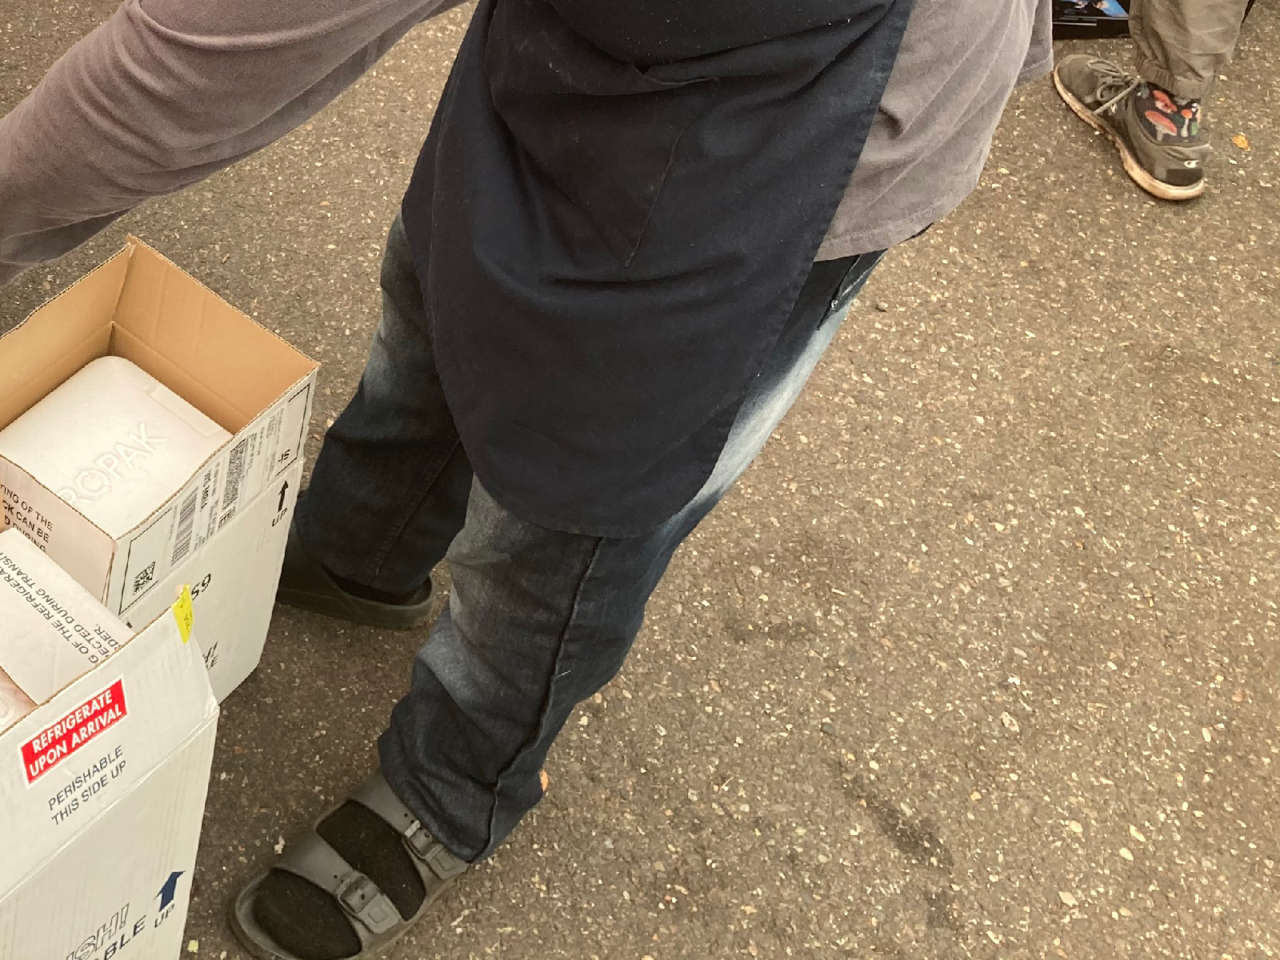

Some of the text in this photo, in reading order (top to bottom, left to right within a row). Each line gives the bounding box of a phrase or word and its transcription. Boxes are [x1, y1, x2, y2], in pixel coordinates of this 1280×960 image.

[16, 510, 36, 533] CAN
[36, 528, 50, 544] BE
[21, 500, 33, 514] OF
[36, 509, 54, 531] THE
[271, 507, 288, 528] UP
[35, 587, 75, 624] DURING
[51, 618, 73, 642] THE
[71, 640, 90, 655] OF
[31, 689, 113, 754] REFRIGERATE
[29, 703, 123, 777] UPON ARRIVAL
[48, 744, 123, 811] PERISHABLE
[51, 760, 127, 826] THIS SIDE UP
[154, 903, 176, 929] UP
